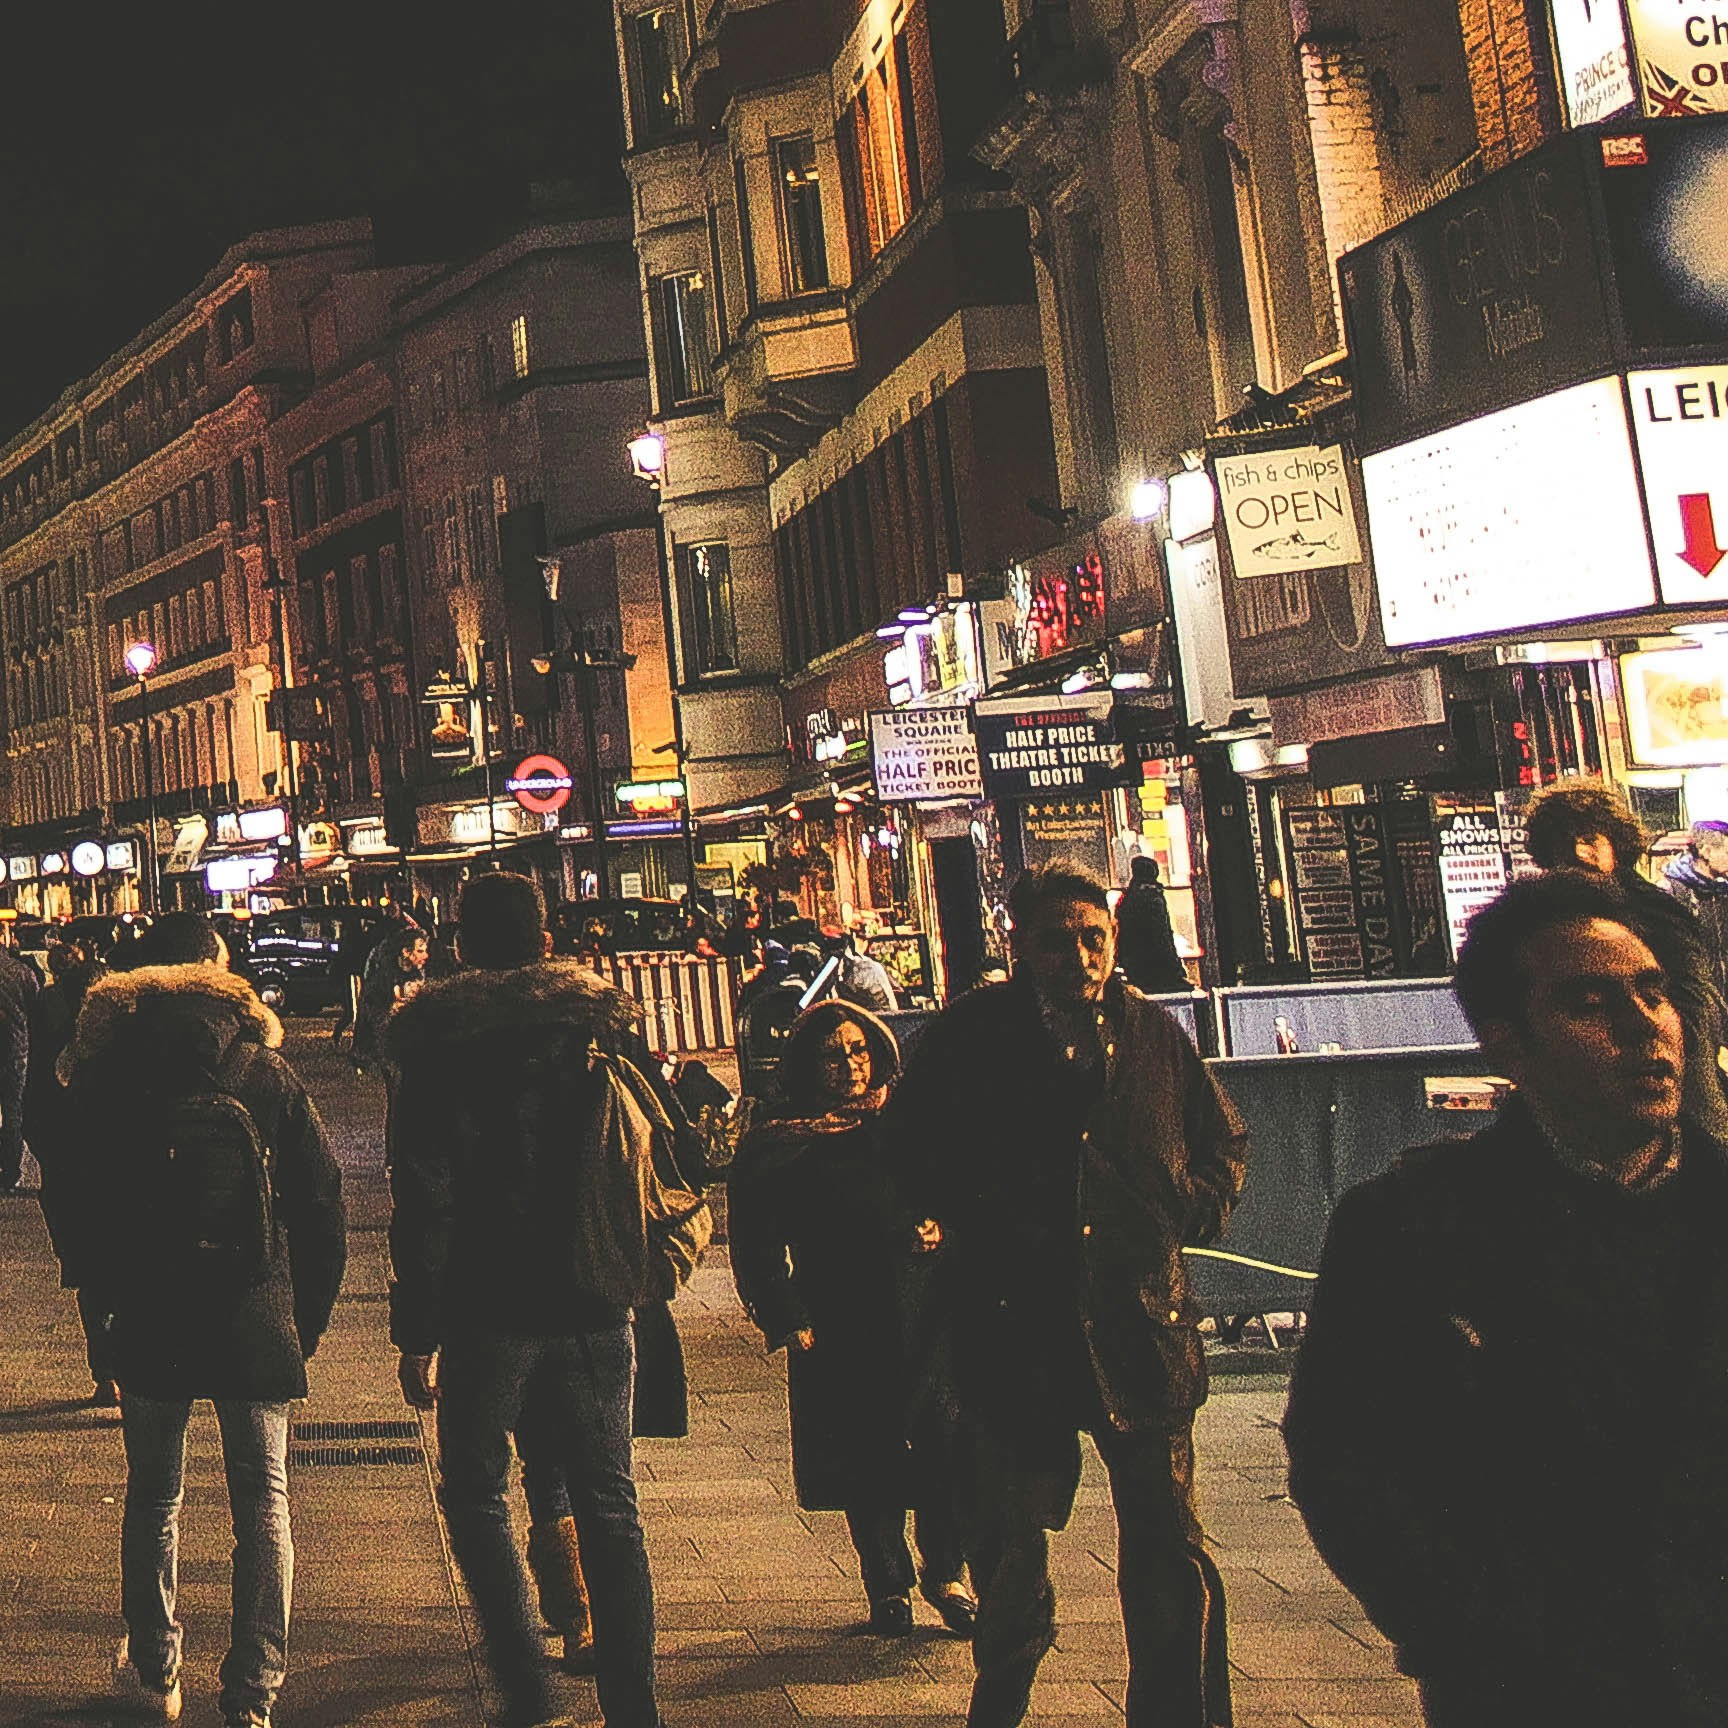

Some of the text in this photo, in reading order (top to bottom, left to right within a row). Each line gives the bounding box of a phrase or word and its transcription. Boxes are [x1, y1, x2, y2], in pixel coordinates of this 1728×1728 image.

[1645, 380, 1728, 422] LEI
[1224, 456, 1340, 494] fish & chips
[1235, 486, 1344, 530] OPEN
[894, 725, 962, 738] SQUARE
[1005, 725, 1096, 748] HALF PRICE
[915, 745, 977, 757] OFFICIAL
[989, 750, 1057, 770] THEATRE
[878, 762, 927, 780] HALF
[1029, 767, 1085, 787] BOOTH
[879, 782, 932, 795] TICKET
[1452, 815, 1486, 831] ALL
[1440, 828, 1500, 845] SHOWS
[1351, 813, 1387, 908] SAME
